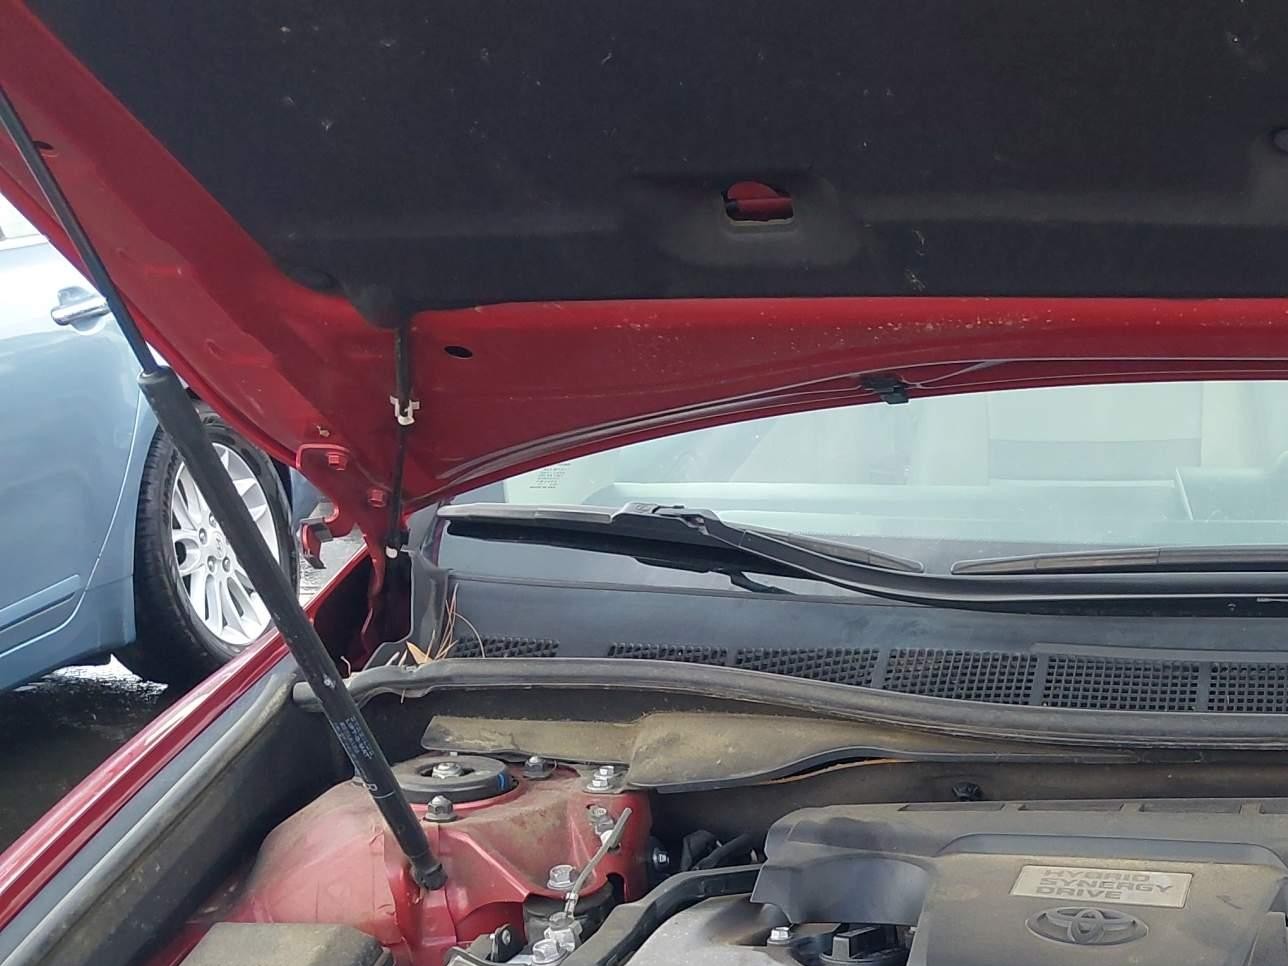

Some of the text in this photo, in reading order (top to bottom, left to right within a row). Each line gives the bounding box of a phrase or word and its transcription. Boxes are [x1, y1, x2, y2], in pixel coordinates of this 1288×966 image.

[1044, 870, 1150, 882] HYBRID
[1039, 878, 1173, 893] SYNERGY
[1036, 886, 1122, 900] DRIVE
